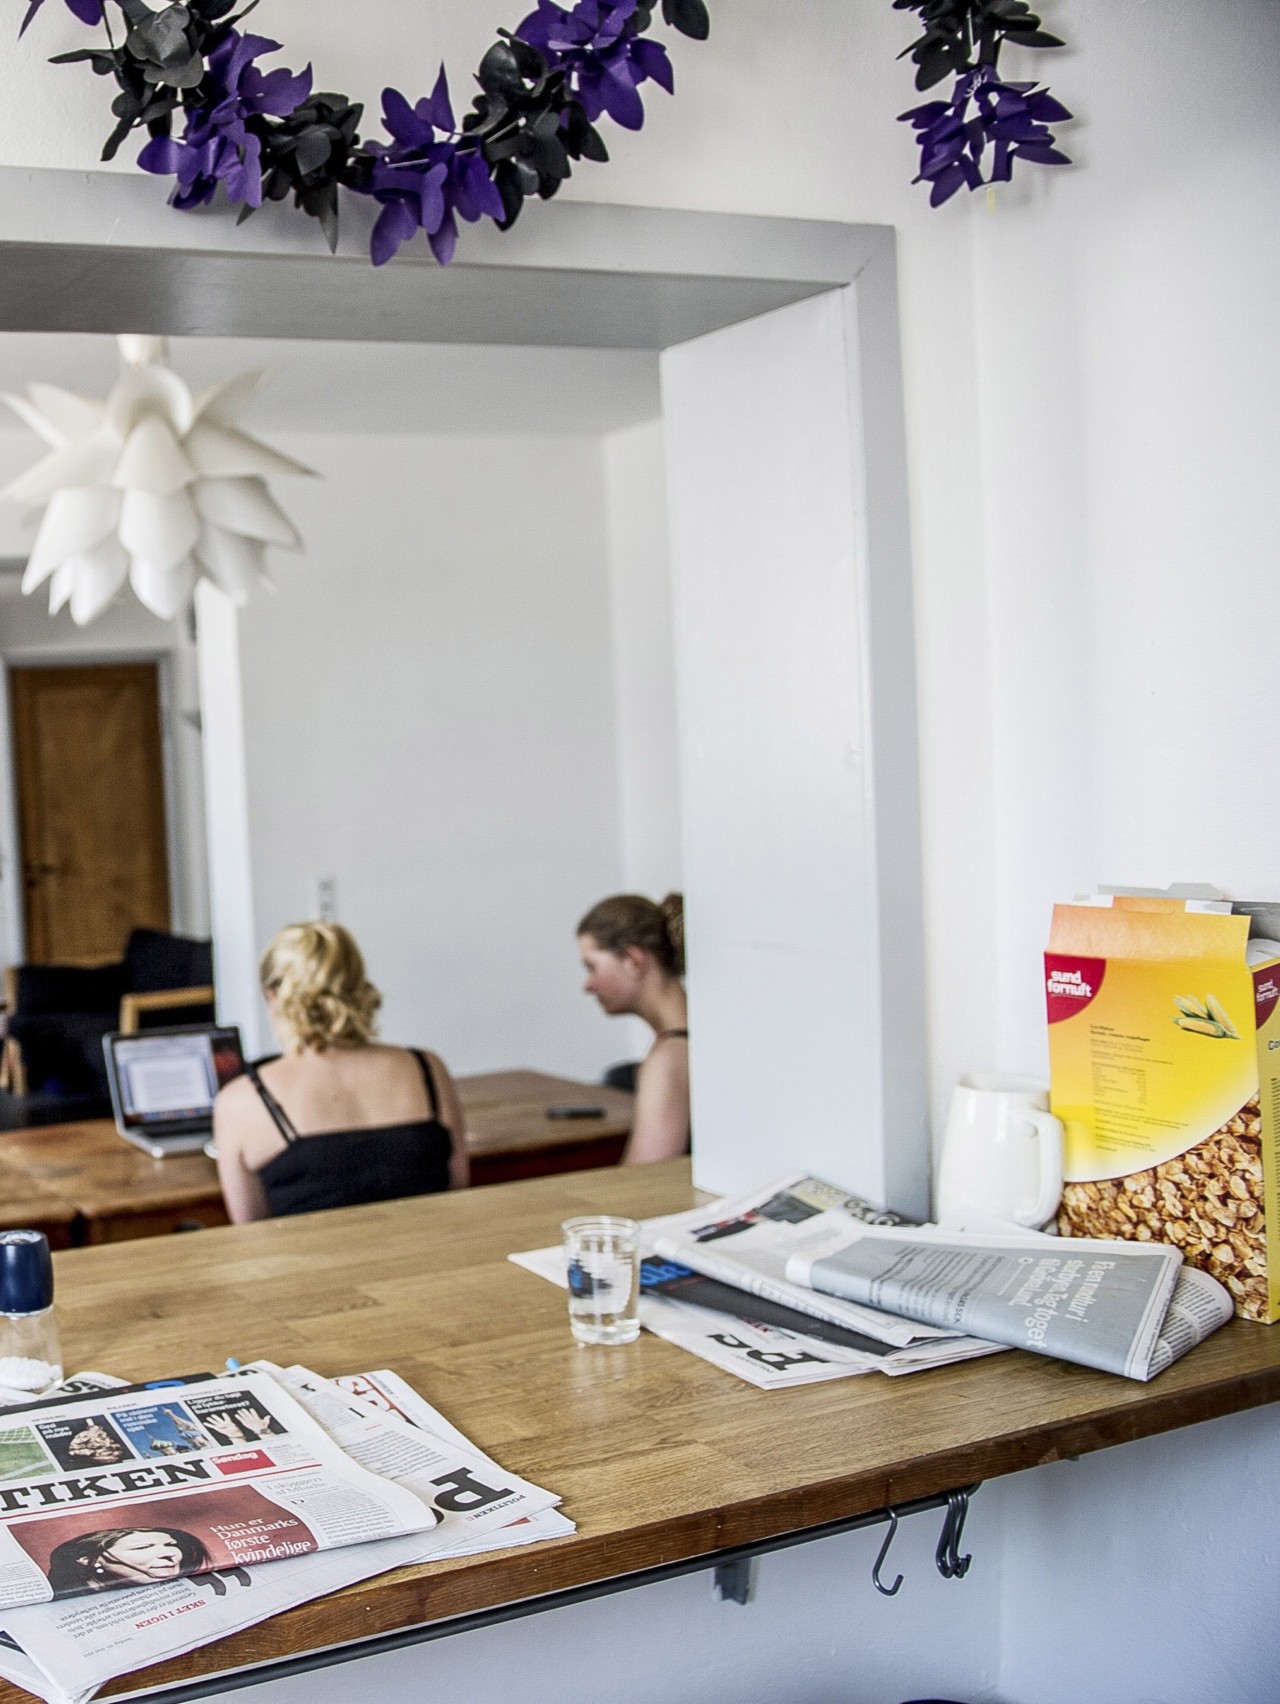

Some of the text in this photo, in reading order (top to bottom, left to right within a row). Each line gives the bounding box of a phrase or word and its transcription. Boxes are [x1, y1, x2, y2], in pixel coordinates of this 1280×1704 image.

[1050, 968, 1081, 983] sund
[1025, 1307, 1059, 1349] toget
[211, 1450, 259, 1466] Søndag
[209, 1517, 265, 1533] Hun er
[216, 1518, 299, 1540] Danmarks
[223, 1534, 270, 1550] første
[231, 1540, 313, 1565] kvindelige
[175, 1598, 206, 1615] SKET
[135, 1612, 169, 1630] UGEN
